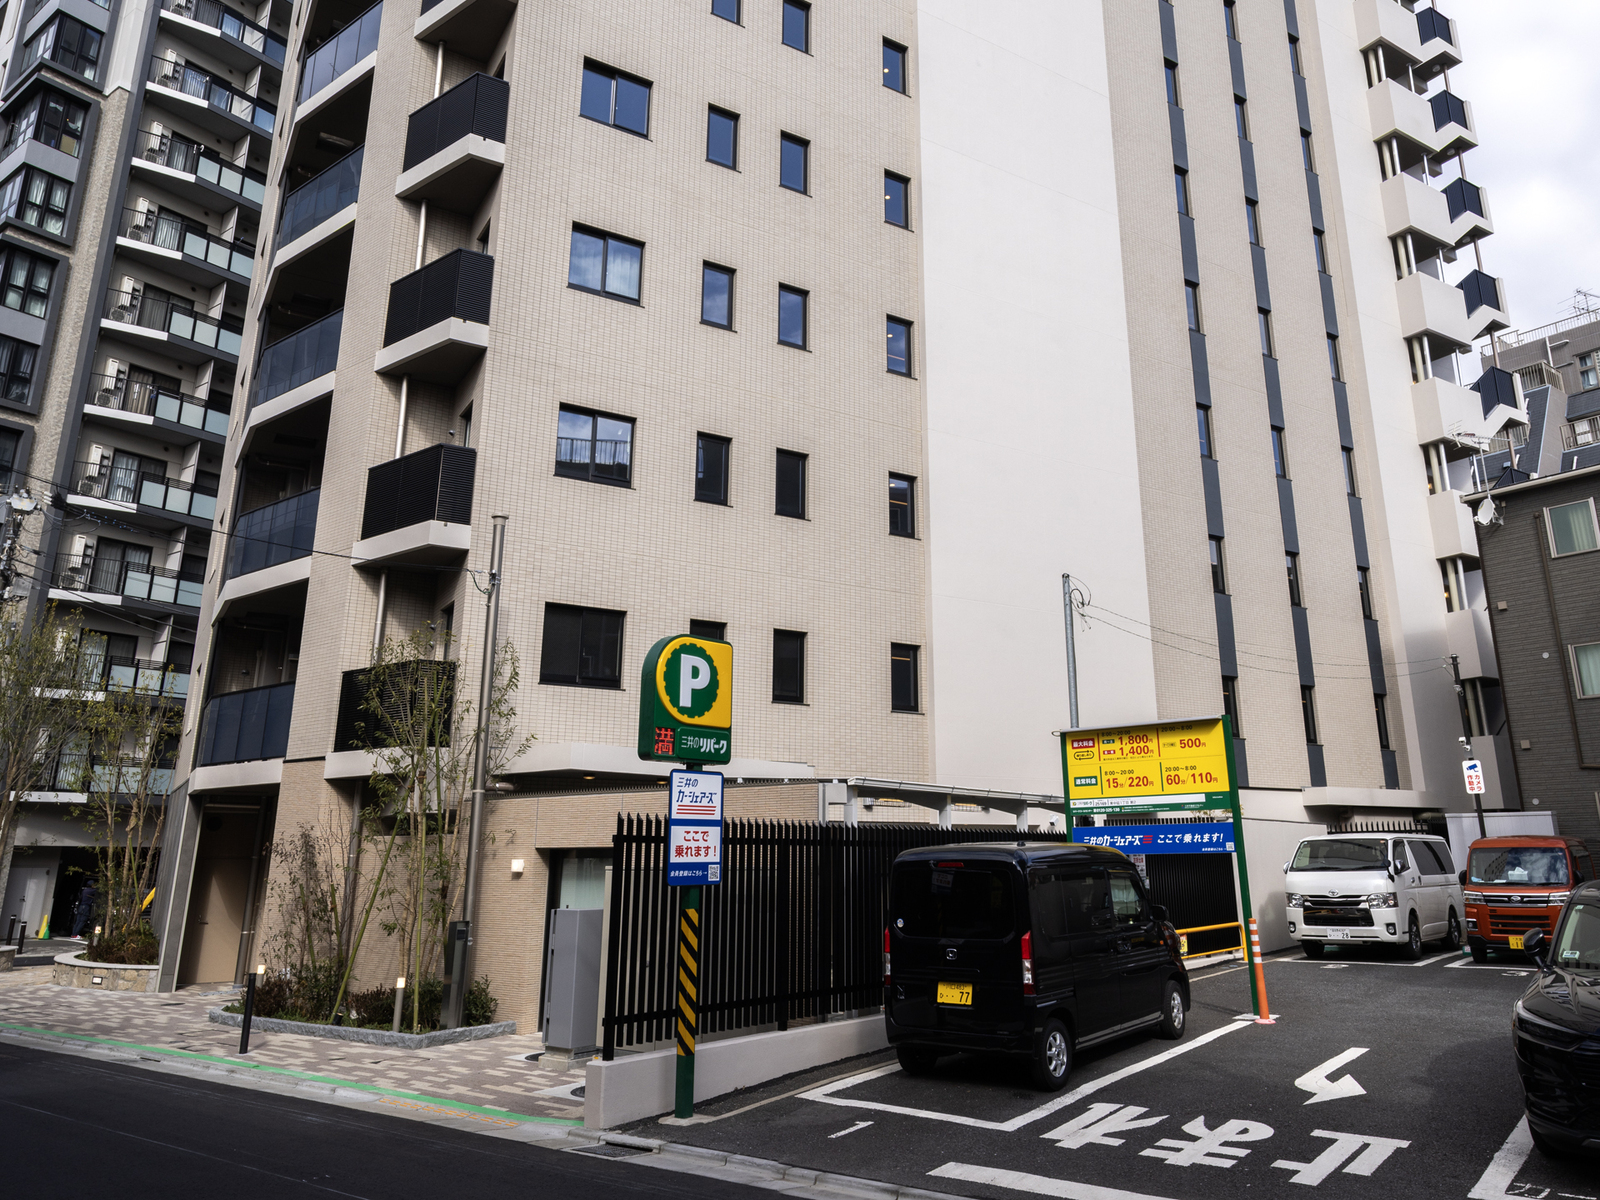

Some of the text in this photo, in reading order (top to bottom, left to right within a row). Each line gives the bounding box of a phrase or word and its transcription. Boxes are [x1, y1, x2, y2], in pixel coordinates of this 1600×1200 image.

[680, 654, 710, 707] P
[654, 727, 674, 755] 満
[681, 736, 727, 754] 三井のリパーク
[1118, 734, 1153, 746] 1,800円
[1180, 738, 1206, 749] 500円
[1119, 745, 1154, 756] 1,400円
[677, 777, 698, 789] 三井の
[1467, 775, 1475, 792] 作動中
[676, 790, 717, 804] カーシェアーズ
[683, 831, 709, 842] ここで
[828, 1121, 874, 1139] 1
